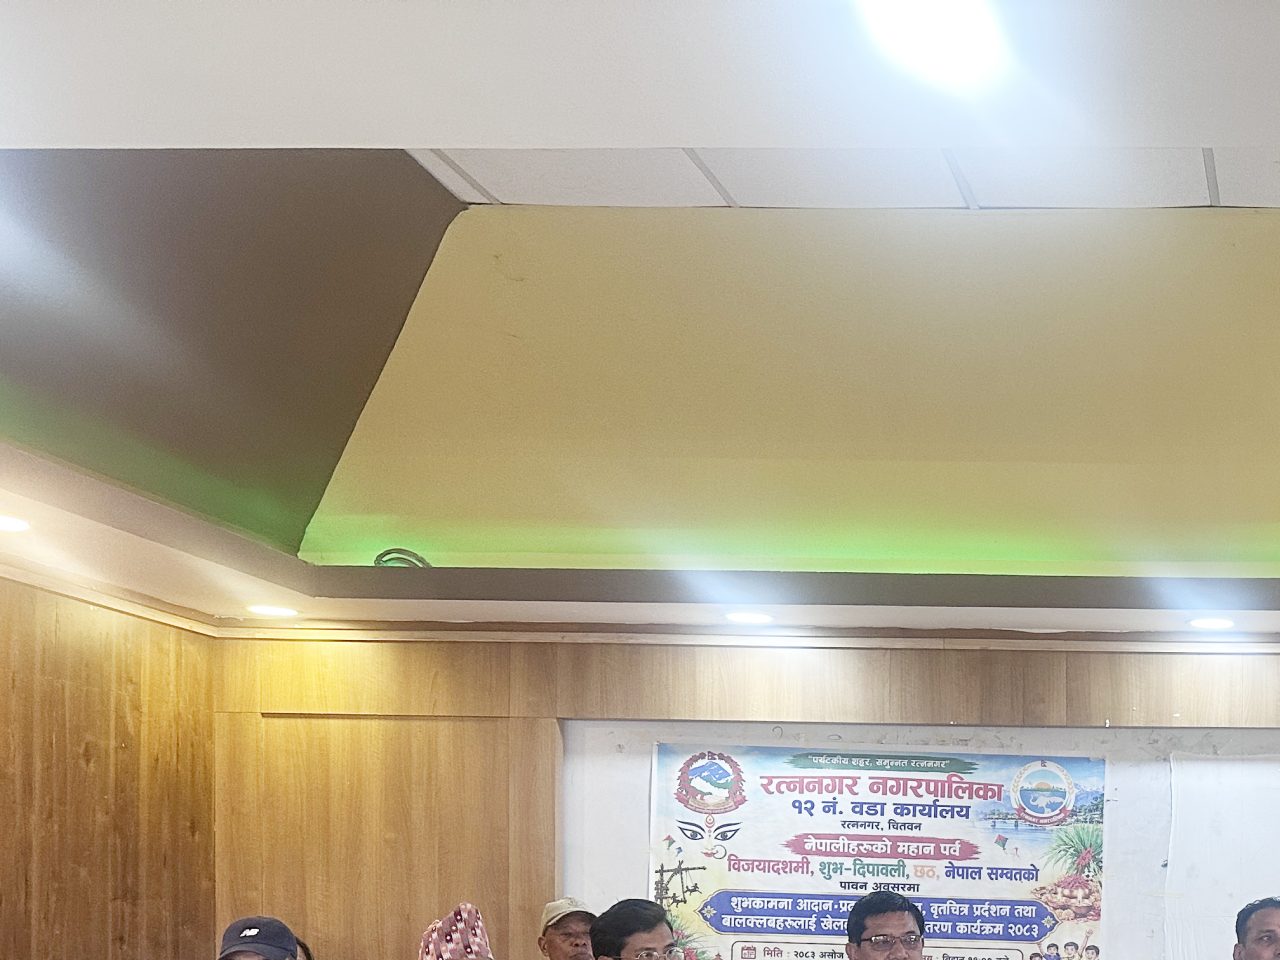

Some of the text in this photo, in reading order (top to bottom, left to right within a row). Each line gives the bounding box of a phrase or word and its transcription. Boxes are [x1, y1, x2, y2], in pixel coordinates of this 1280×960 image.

[760, 772, 1004, 801] रत्ननगर नगरपालिका
[791, 799, 815, 817] १२
[851, 801, 885, 817] वडा
[893, 799, 971, 819] कार्यालय
[888, 819, 922, 831] चितवन
[897, 842, 935, 856] महान
[940, 840, 961, 857] पर्व
[727, 855, 815, 876] विजयादशमी,
[945, 861, 982, 881] नेपाल
[840, 881, 920, 892] पावन अवसरमा
[730, 896, 793, 913] शुभकामना
[1014, 905, 1036, 918] तथा
[925, 921, 952, 934] तरण
[956, 919, 1004, 936] कार्यक्रम
[1007, 923, 1039, 938] २०८३
[763, 946, 844, 960] मिति २०८३ असोज
